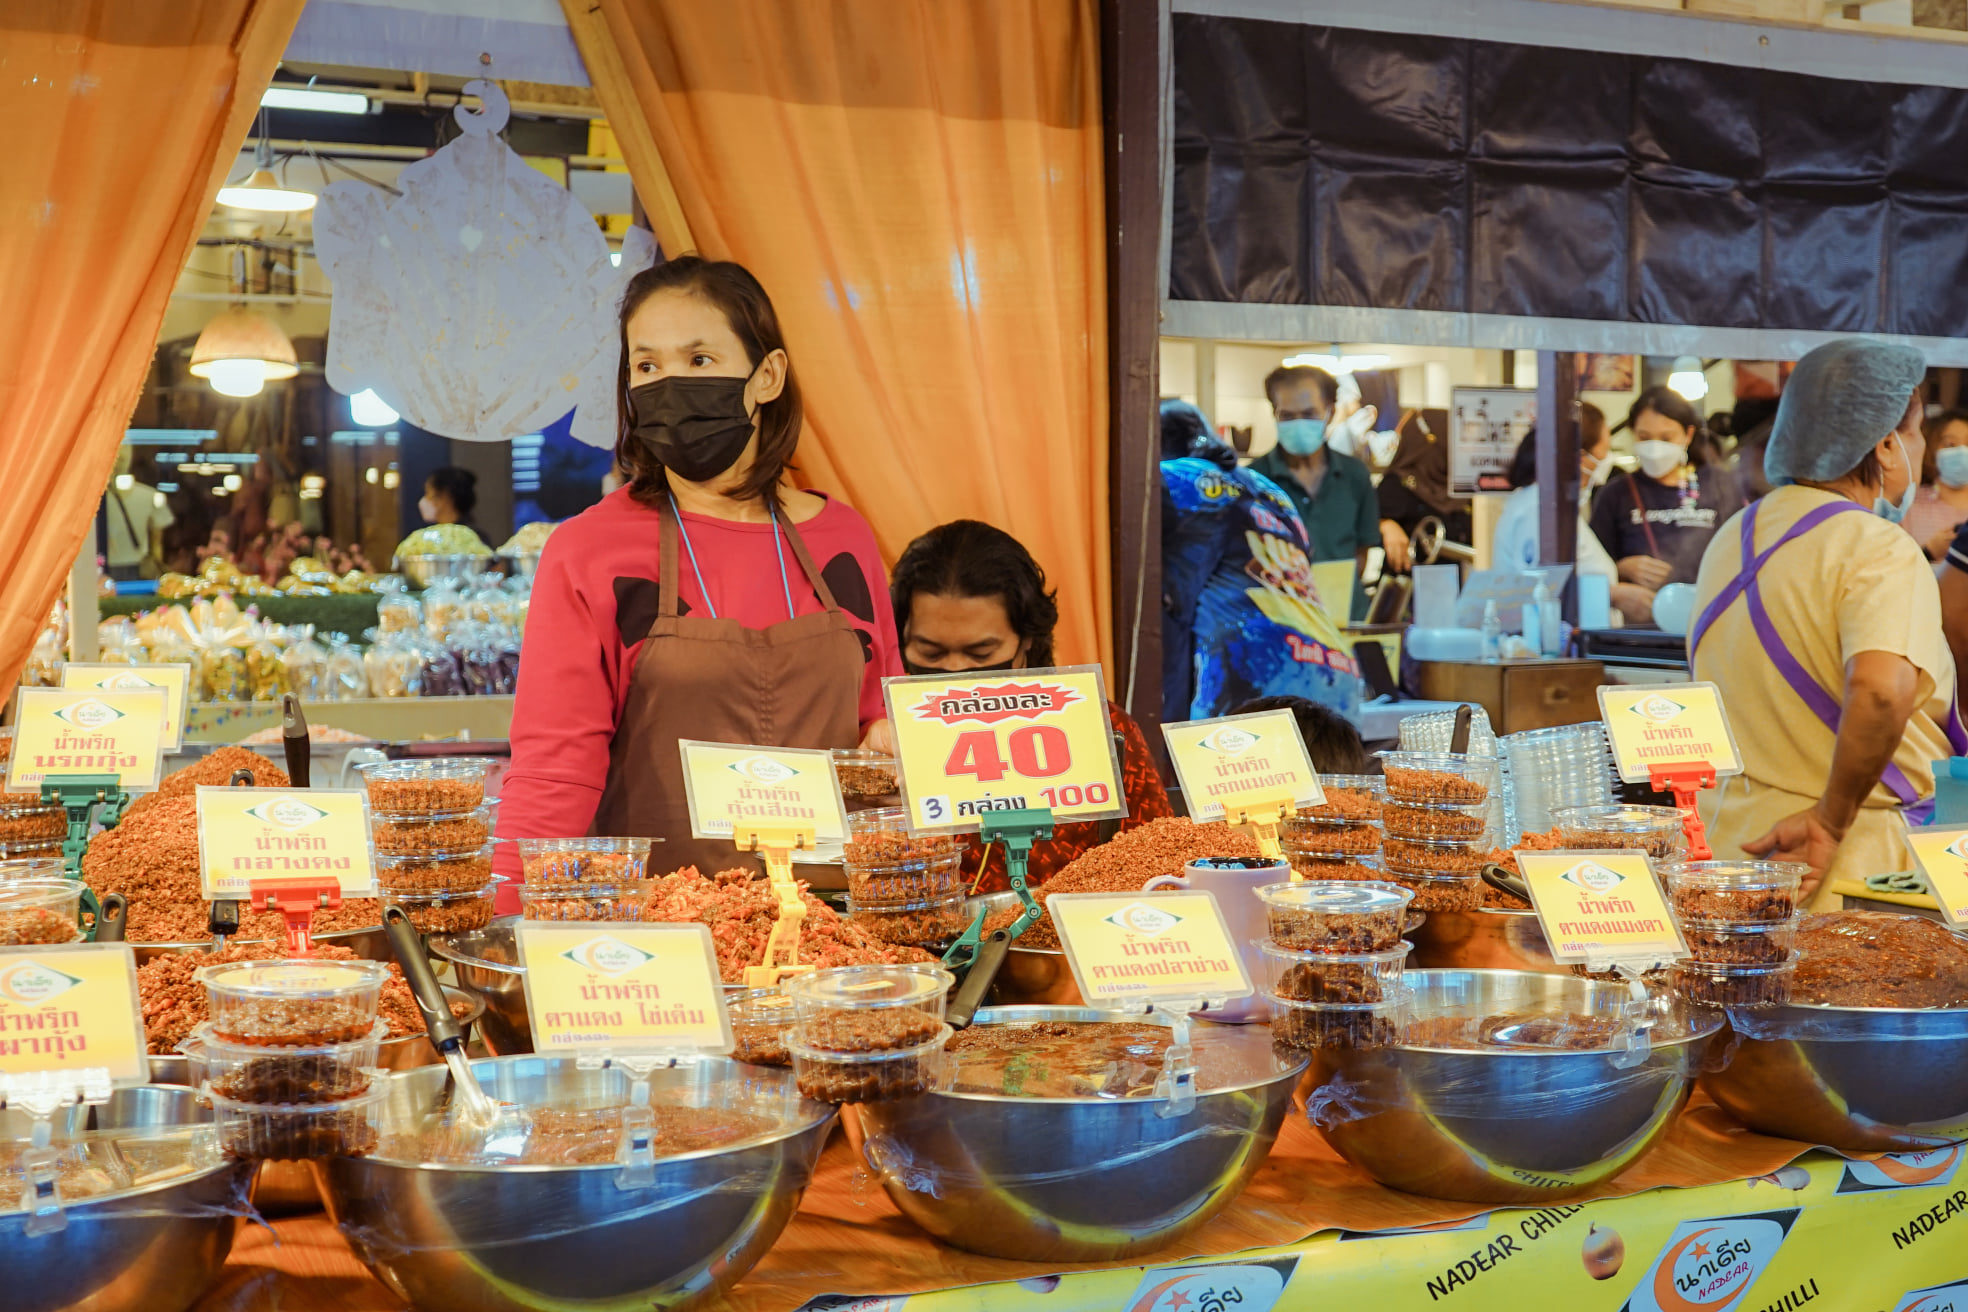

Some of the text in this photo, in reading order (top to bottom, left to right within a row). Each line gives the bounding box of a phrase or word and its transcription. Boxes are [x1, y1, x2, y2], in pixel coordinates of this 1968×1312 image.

[940, 691, 1053, 716] กล่องละ
[54, 729, 116, 750] น้ำพริก
[1643, 721, 1693, 741] น้ำพริก
[33, 751, 137, 772] นรกกุ้ง
[945, 725, 1072, 782] 40
[1215, 756, 1271, 777] น้ำพริก
[738, 781, 801, 801] น้ำพริก
[1206, 771, 1297, 796] นรกแมงดา
[925, 798, 943, 819] 3
[1040, 782, 1110, 808] 100
[255, 828, 326, 850] น้ำพริก
[1577, 892, 1635, 914] น้ำพริก
[1559, 920, 1664, 935] ตาแดงแมงดา
[1121, 934, 1191, 956] น้ำพริก
[1092, 955, 1230, 979] ตาแดงปลาย่าง
[579, 974, 660, 1000] น้ำพริก
[545, 1011, 623, 1027] ตาแดง
[1892, 1190, 1968, 1249] NADEAR
[1426, 1204, 1585, 1301] NADEAR CHILL
[1676, 1238, 1751, 1292] นาเดีย
[1698, 1261, 1749, 1301] NADEAR
